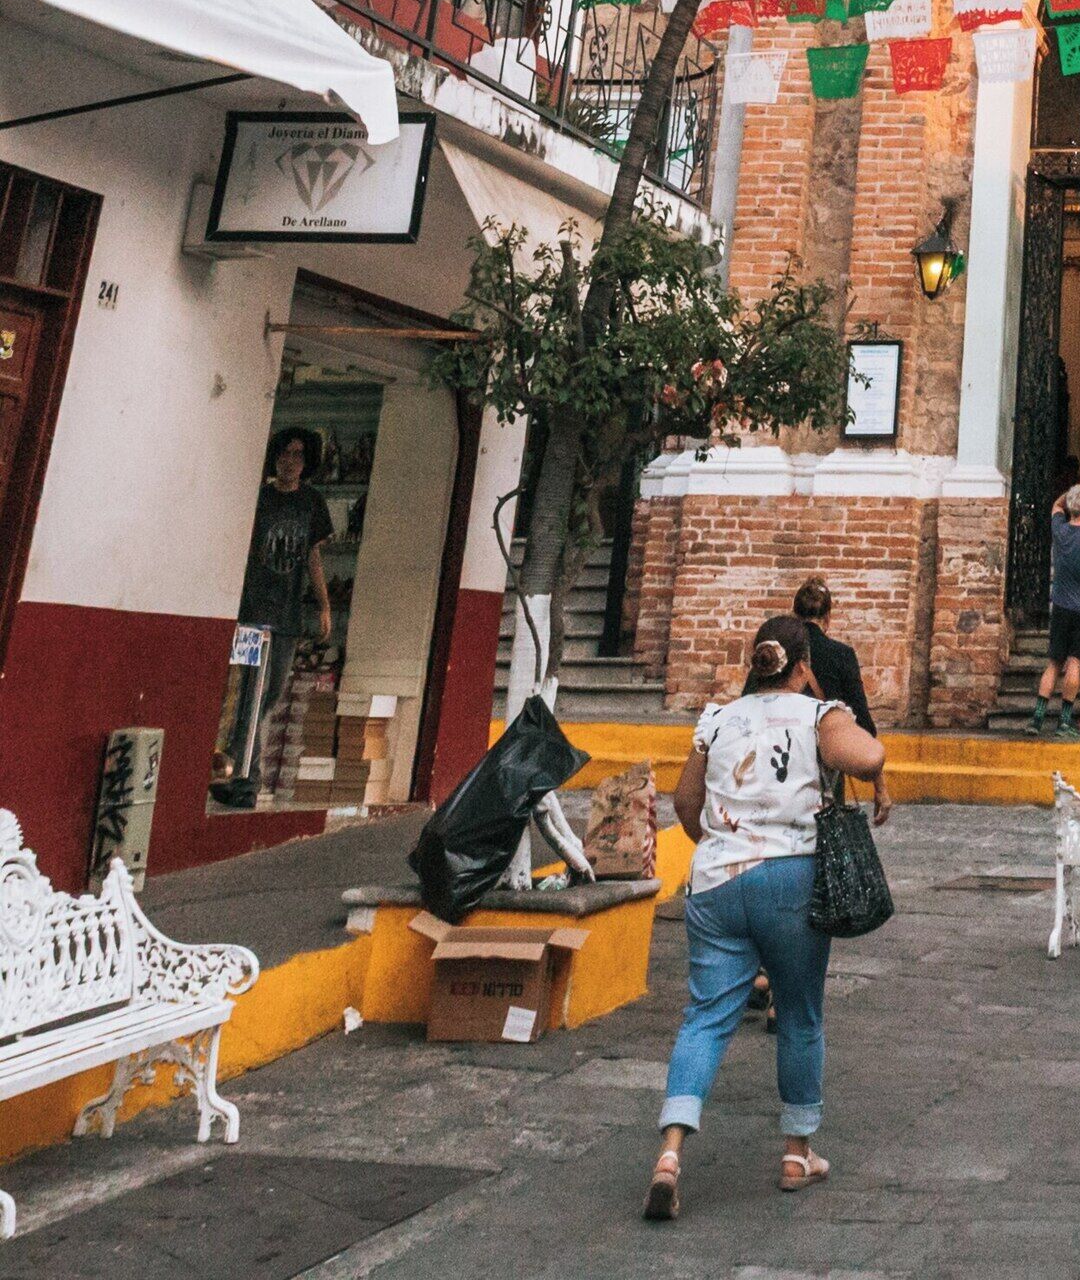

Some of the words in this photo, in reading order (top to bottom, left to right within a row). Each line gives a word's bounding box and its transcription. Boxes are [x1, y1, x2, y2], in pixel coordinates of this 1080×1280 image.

[318, 127, 329, 139] el
[332, 127, 367, 139] Diam
[283, 217, 299, 228] De
[301, 216, 347, 228] Arellano
[98, 281, 119, 303] 241
